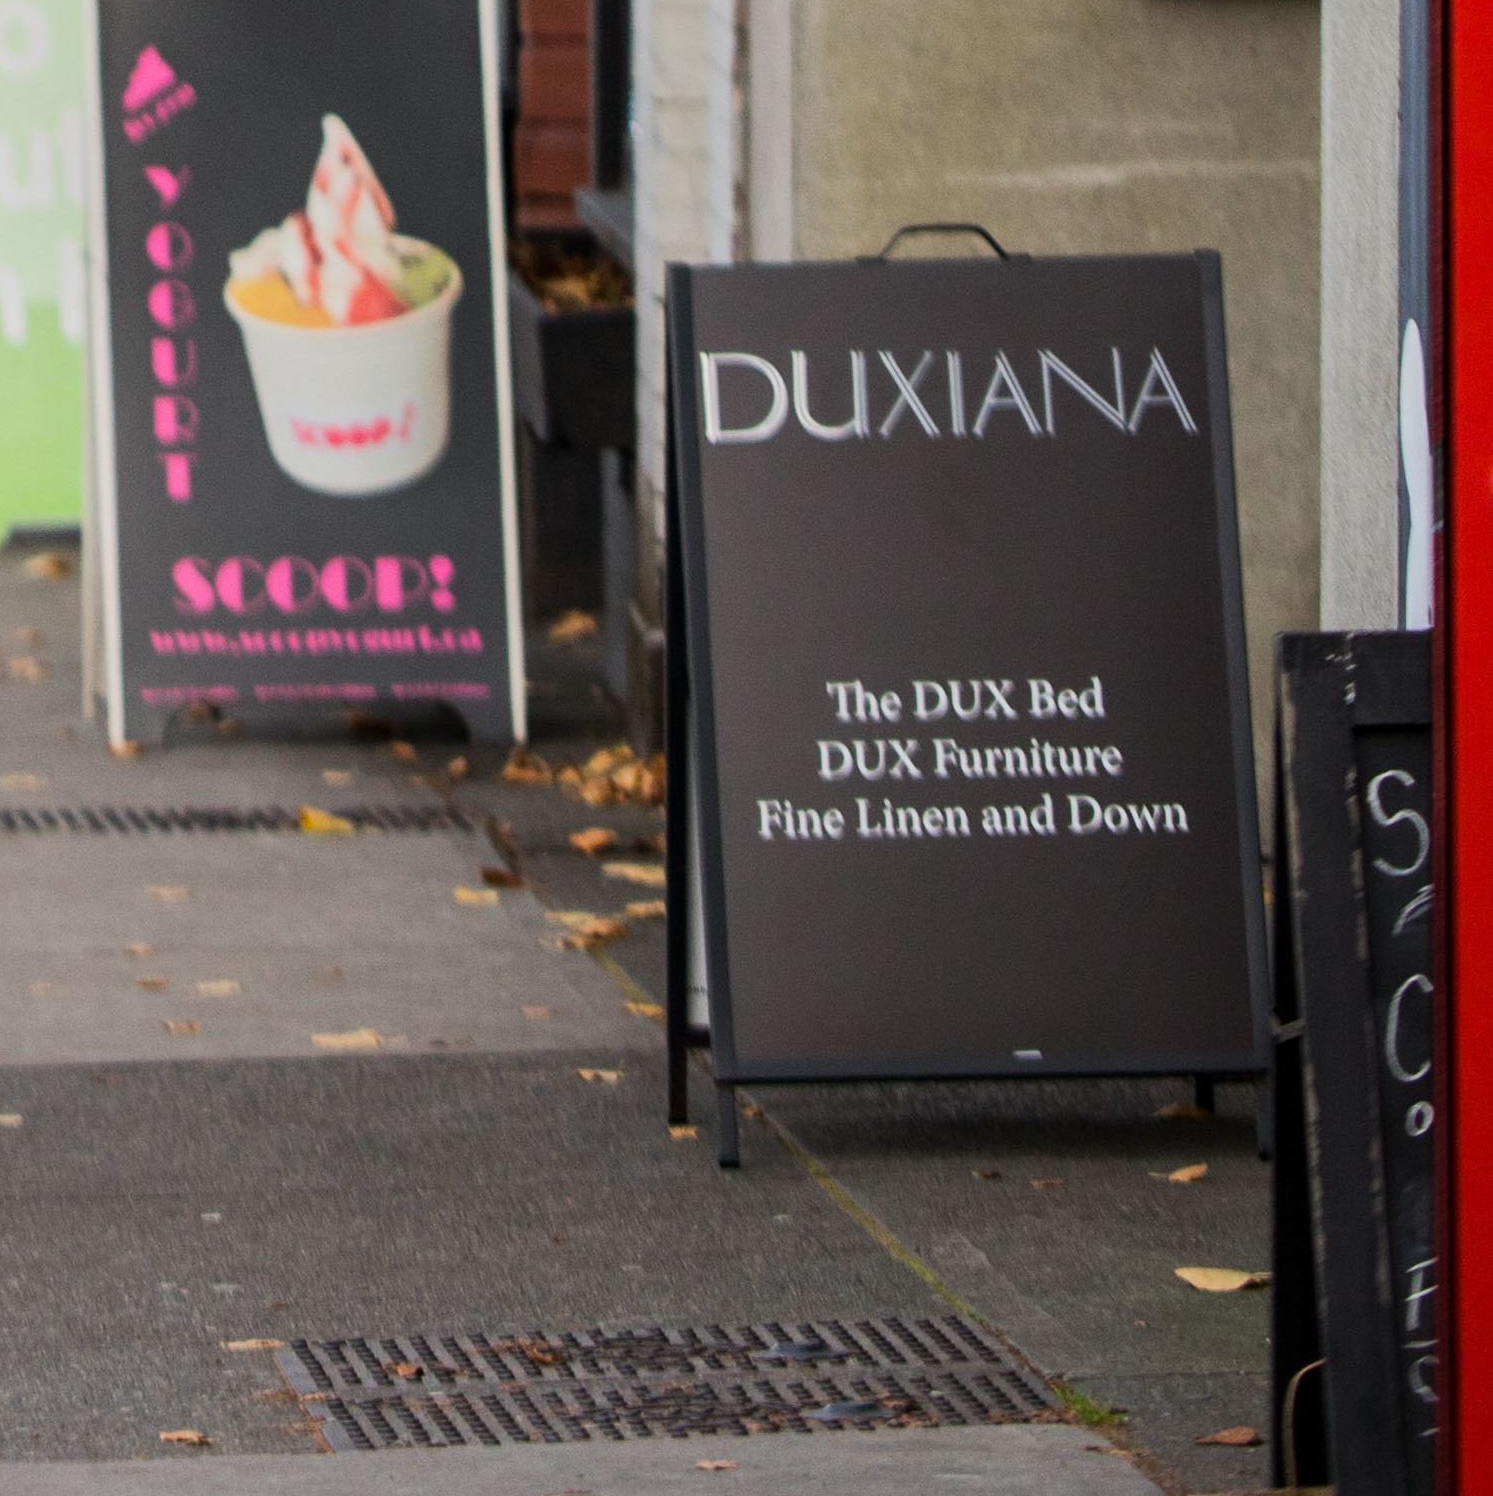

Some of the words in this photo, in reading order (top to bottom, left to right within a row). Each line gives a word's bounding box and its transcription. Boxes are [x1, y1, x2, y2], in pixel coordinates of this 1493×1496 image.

[699, 347, 1198, 444] DUXIANA
[172, 554, 456, 616] SCOOP!
[826, 679, 902, 723] The
[913, 679, 1017, 722] DUX
[1027, 675, 1105, 720] Bed
[817, 738, 922, 781] DUX
[932, 737, 1123, 780] Furniture
[757, 798, 845, 841] Fine
[855, 797, 971, 839] Linen
[981, 792, 1056, 837] and
[1066, 793, 1190, 836] Down
